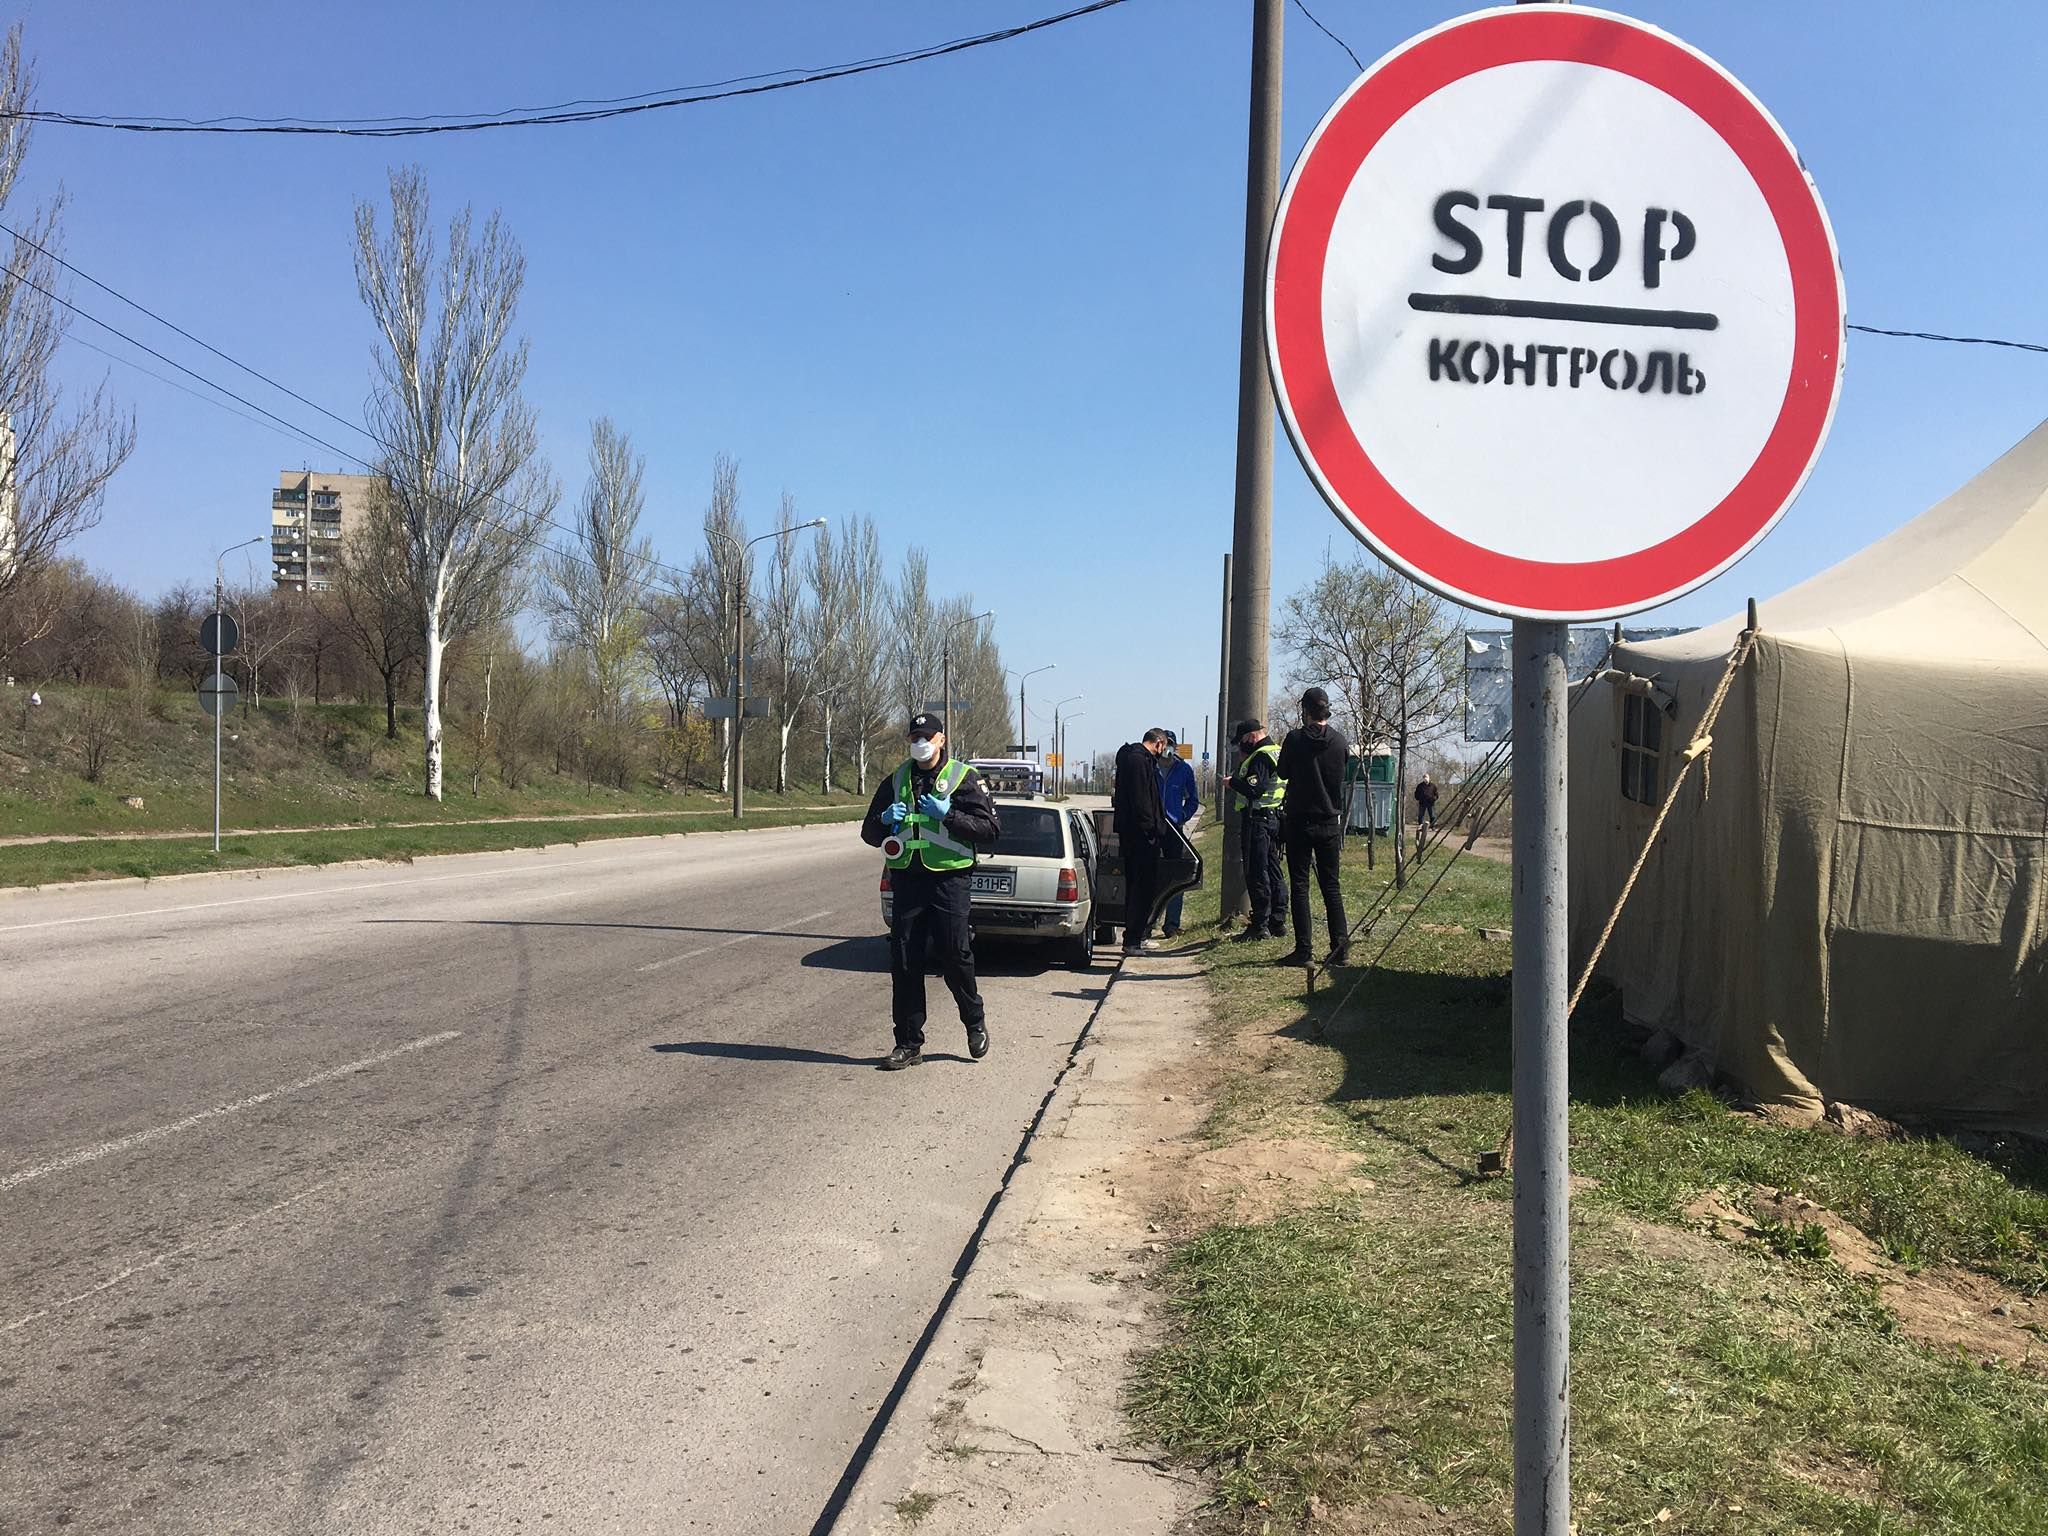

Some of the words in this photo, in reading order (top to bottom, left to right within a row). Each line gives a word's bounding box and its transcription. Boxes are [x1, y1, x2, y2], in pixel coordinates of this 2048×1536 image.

[1432, 190, 1697, 288] STOP
[1429, 338, 1706, 395] КОНТРОЛЬ
[969, 877, 1008, 890] -81HE
